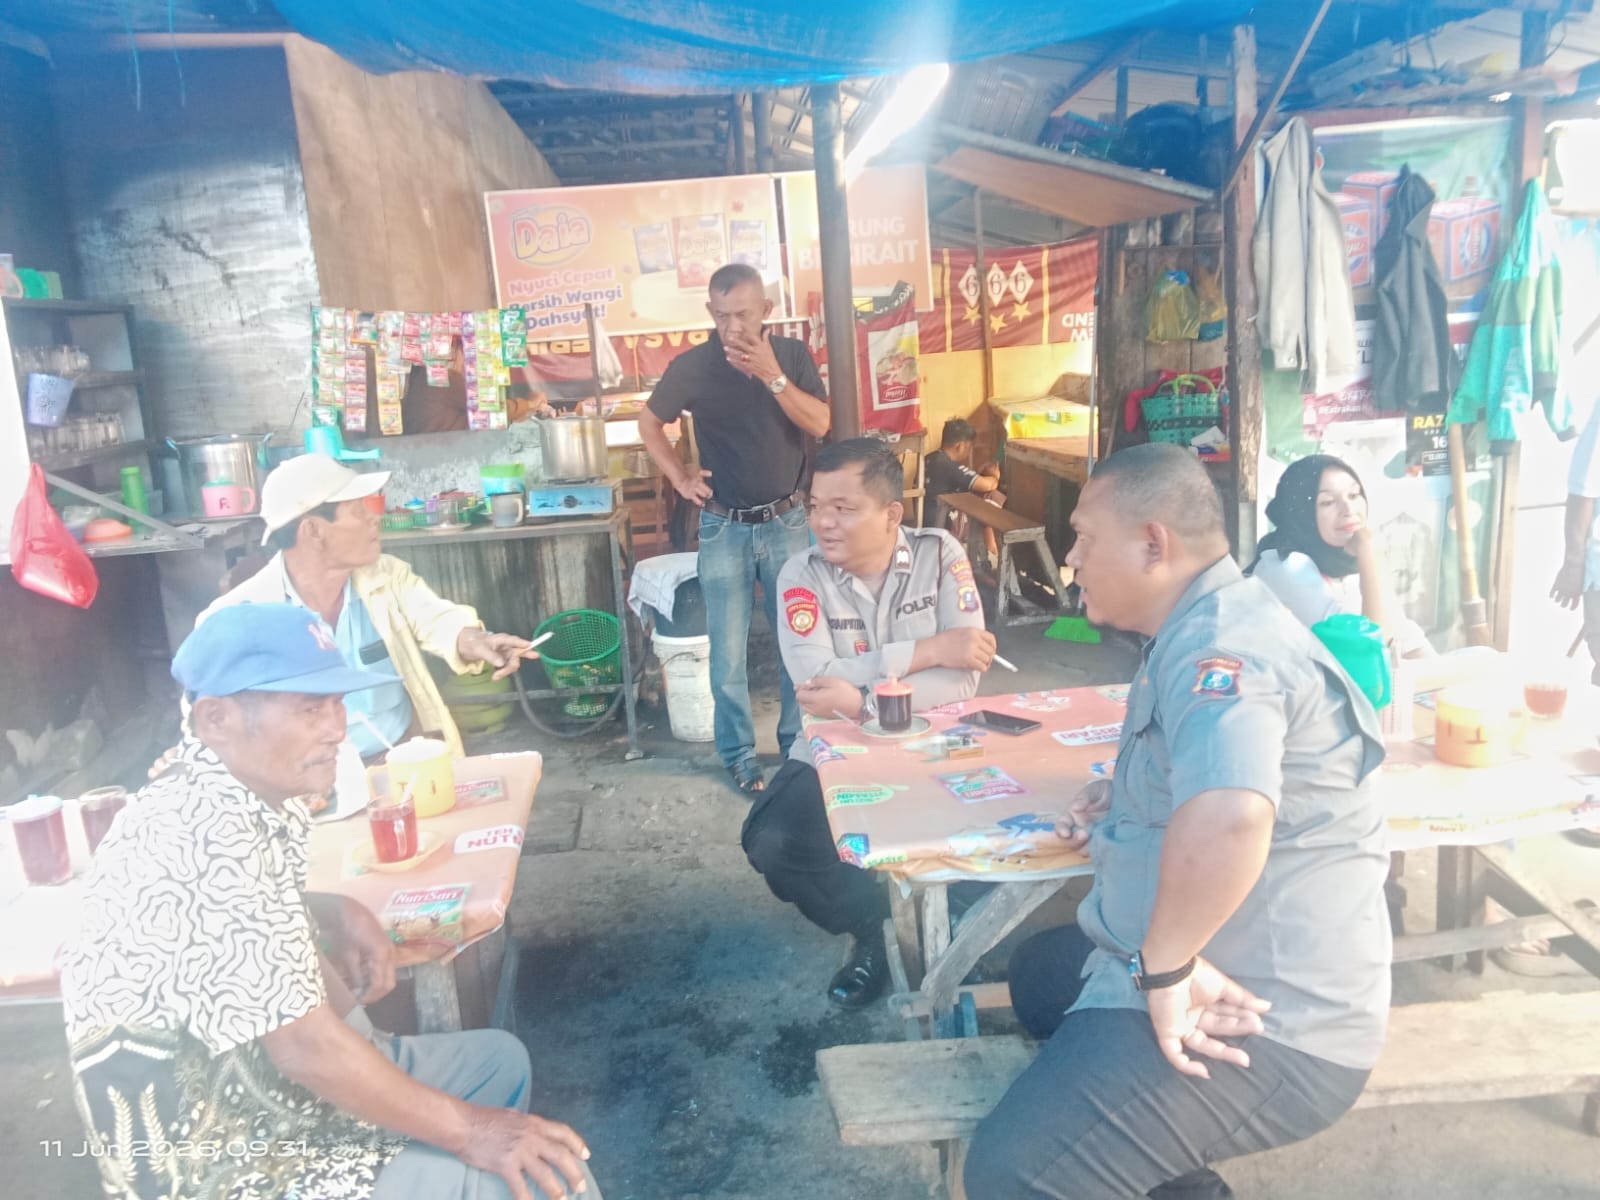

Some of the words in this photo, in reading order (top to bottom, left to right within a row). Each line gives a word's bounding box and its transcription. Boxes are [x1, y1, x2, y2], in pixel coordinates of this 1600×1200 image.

[513, 212, 591, 260] Daia
[850, 239, 919, 265] IRAIT
[509, 275, 559, 296] Nyuci
[563, 268, 614, 285] Cepat
[565, 285, 623, 305] Wangi
